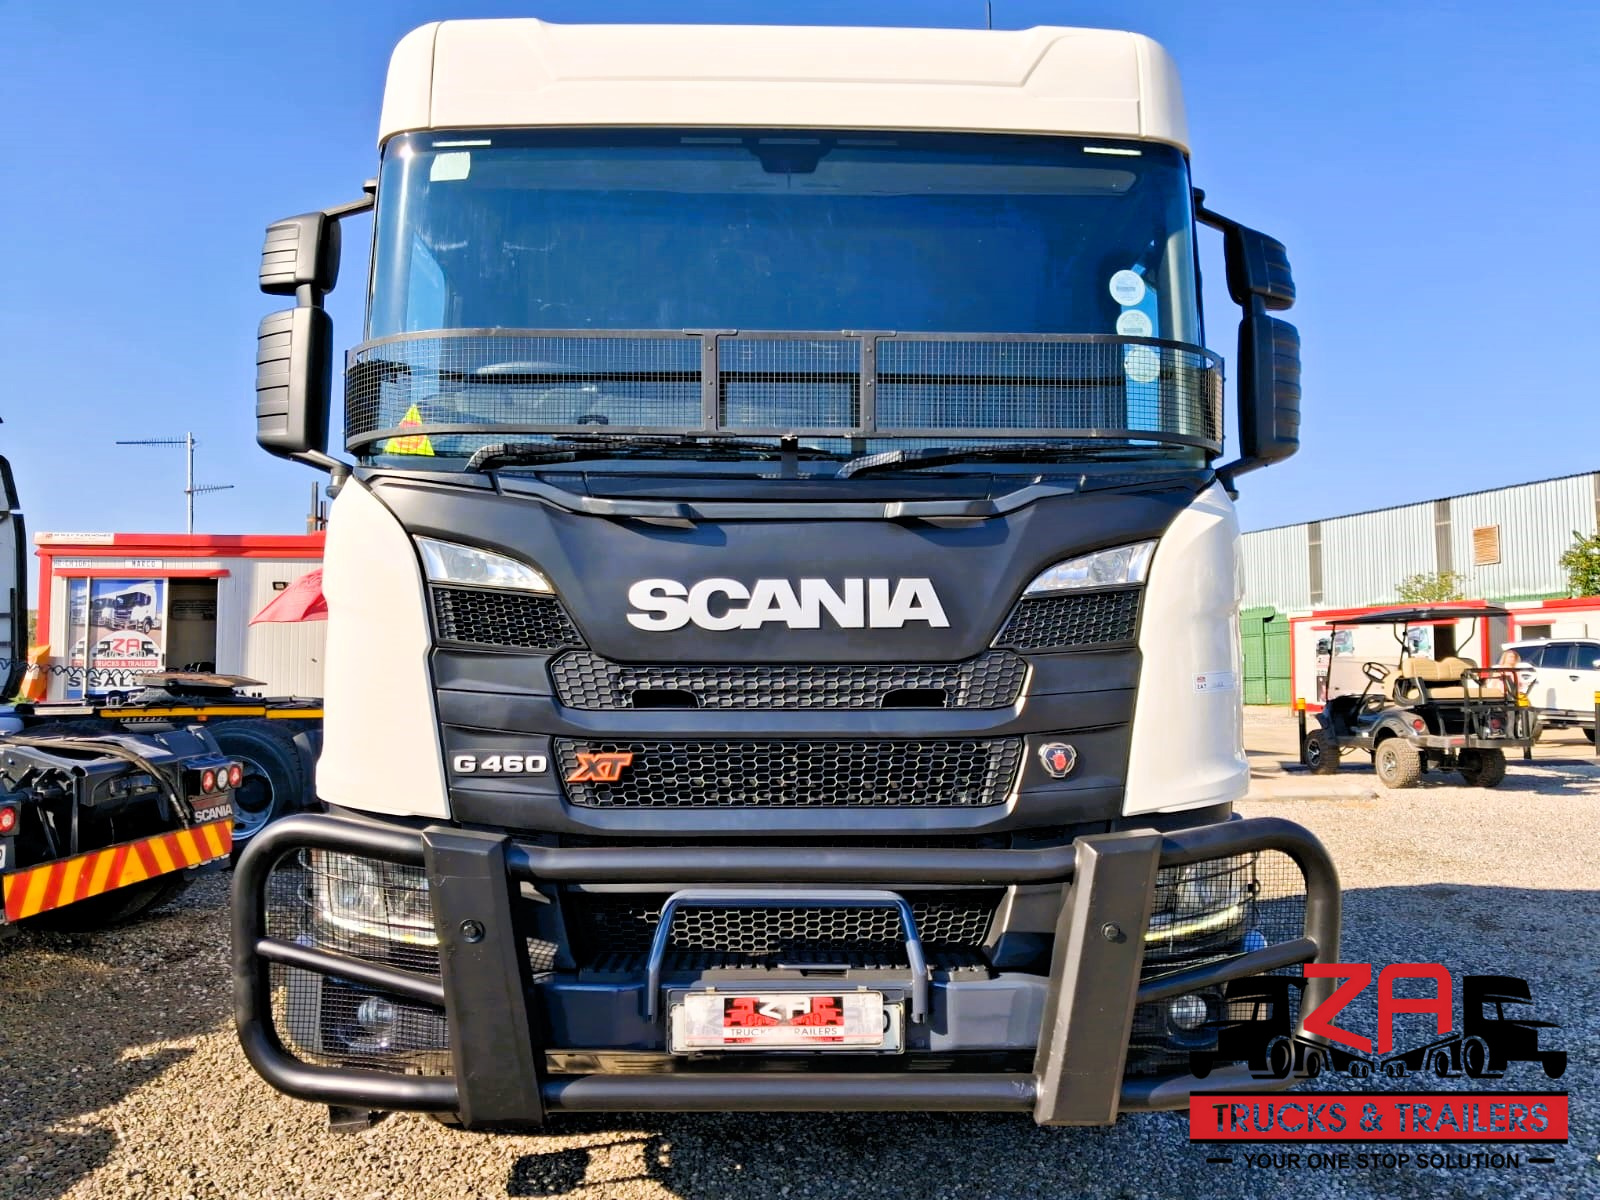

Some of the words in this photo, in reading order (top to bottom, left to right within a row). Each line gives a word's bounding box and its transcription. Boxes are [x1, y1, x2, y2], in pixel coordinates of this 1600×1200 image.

[132, 560, 156, 568] MARCO
[626, 578, 951, 632] SCANIA
[113, 638, 140, 654] ZA
[453, 755, 476, 773] G
[481, 755, 547, 773] 460
[567, 753, 633, 782] XT
[194, 804, 233, 824] SCANIA
[758, 997, 811, 1021] ZA
